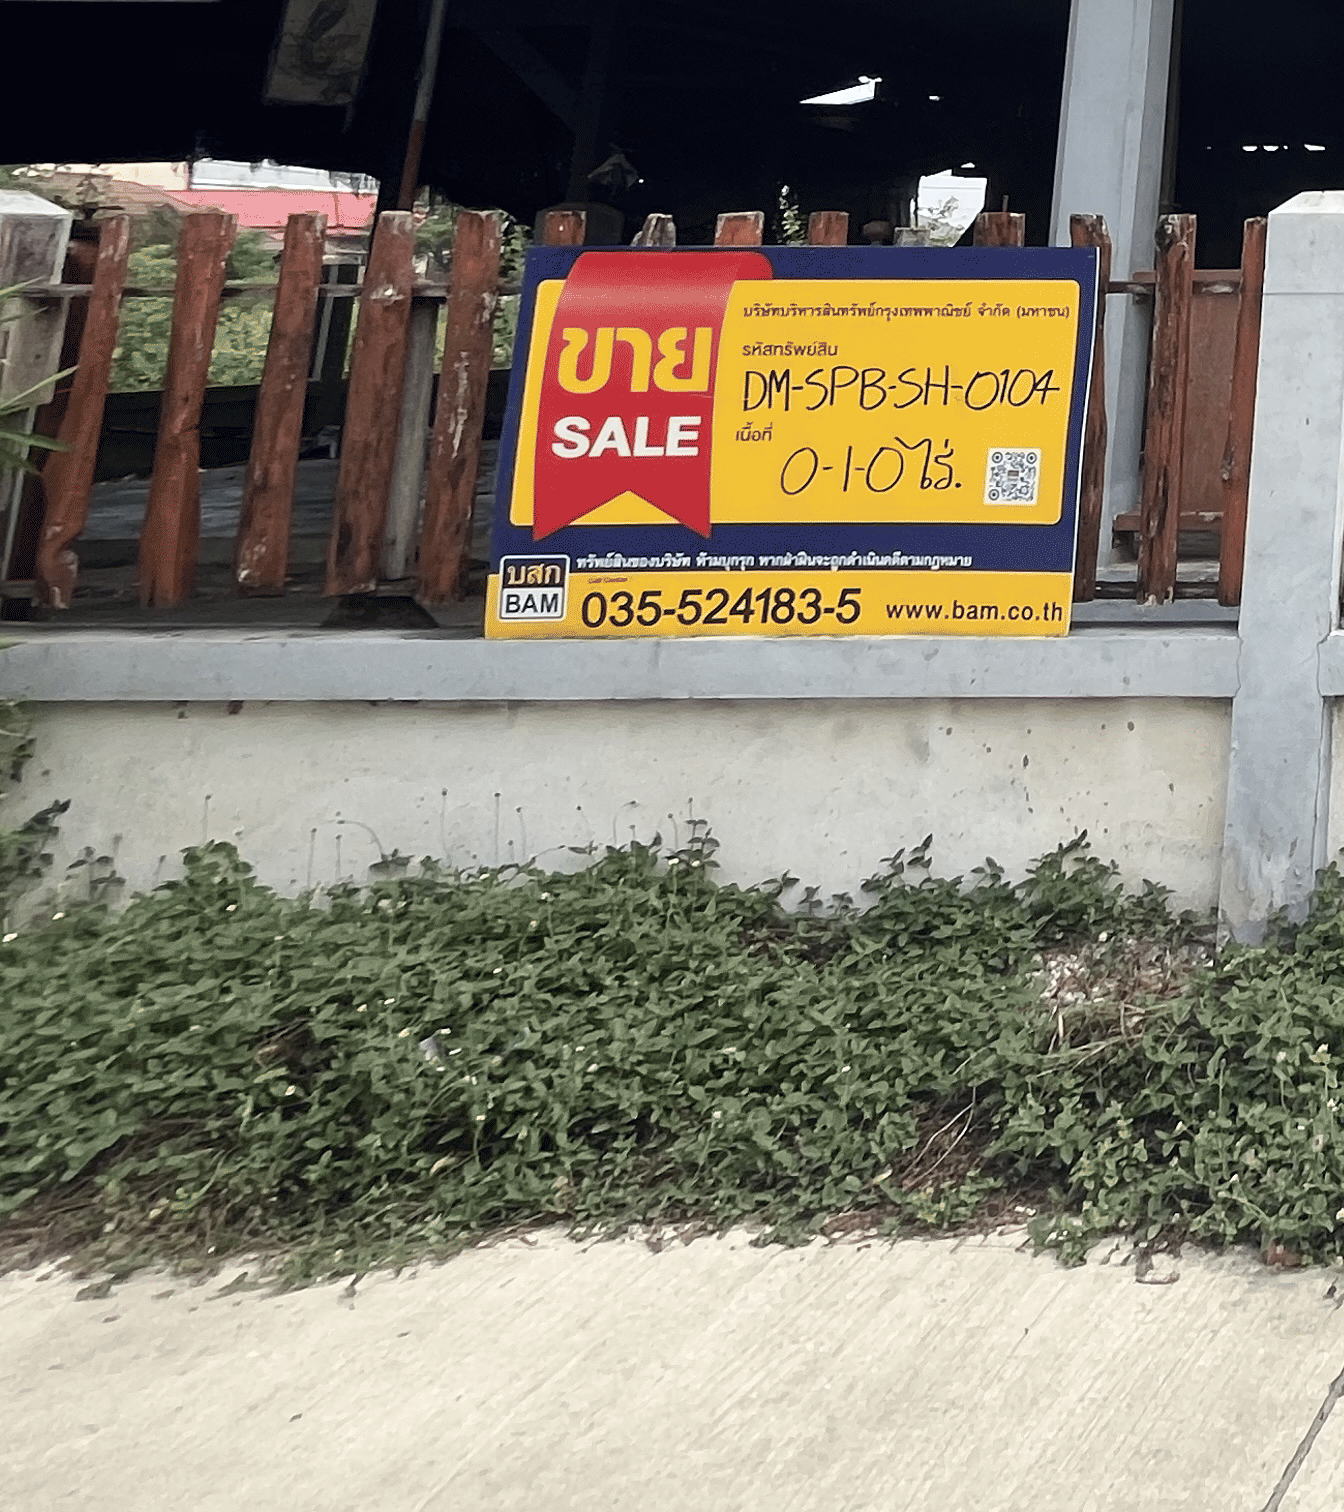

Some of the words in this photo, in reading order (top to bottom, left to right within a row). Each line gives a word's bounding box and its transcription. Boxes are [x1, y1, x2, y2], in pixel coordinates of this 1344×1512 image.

[1016, 305, 1070, 319] (มหาชน)
[742, 340, 839, 357] รหัสทรัพย์สิน
[557, 326, 713, 394] ขาย
[743, 364, 1060, 412] DM-SPB-SH-0104
[551, 415, 702, 459] SALE
[735, 420, 773, 442] เนื้อที่
[507, 563, 561, 585] บสก
[505, 592, 559, 613] BAM
[581, 586, 862, 629] 035-524183-5
[886, 599, 1063, 622] www.bam.co.th
